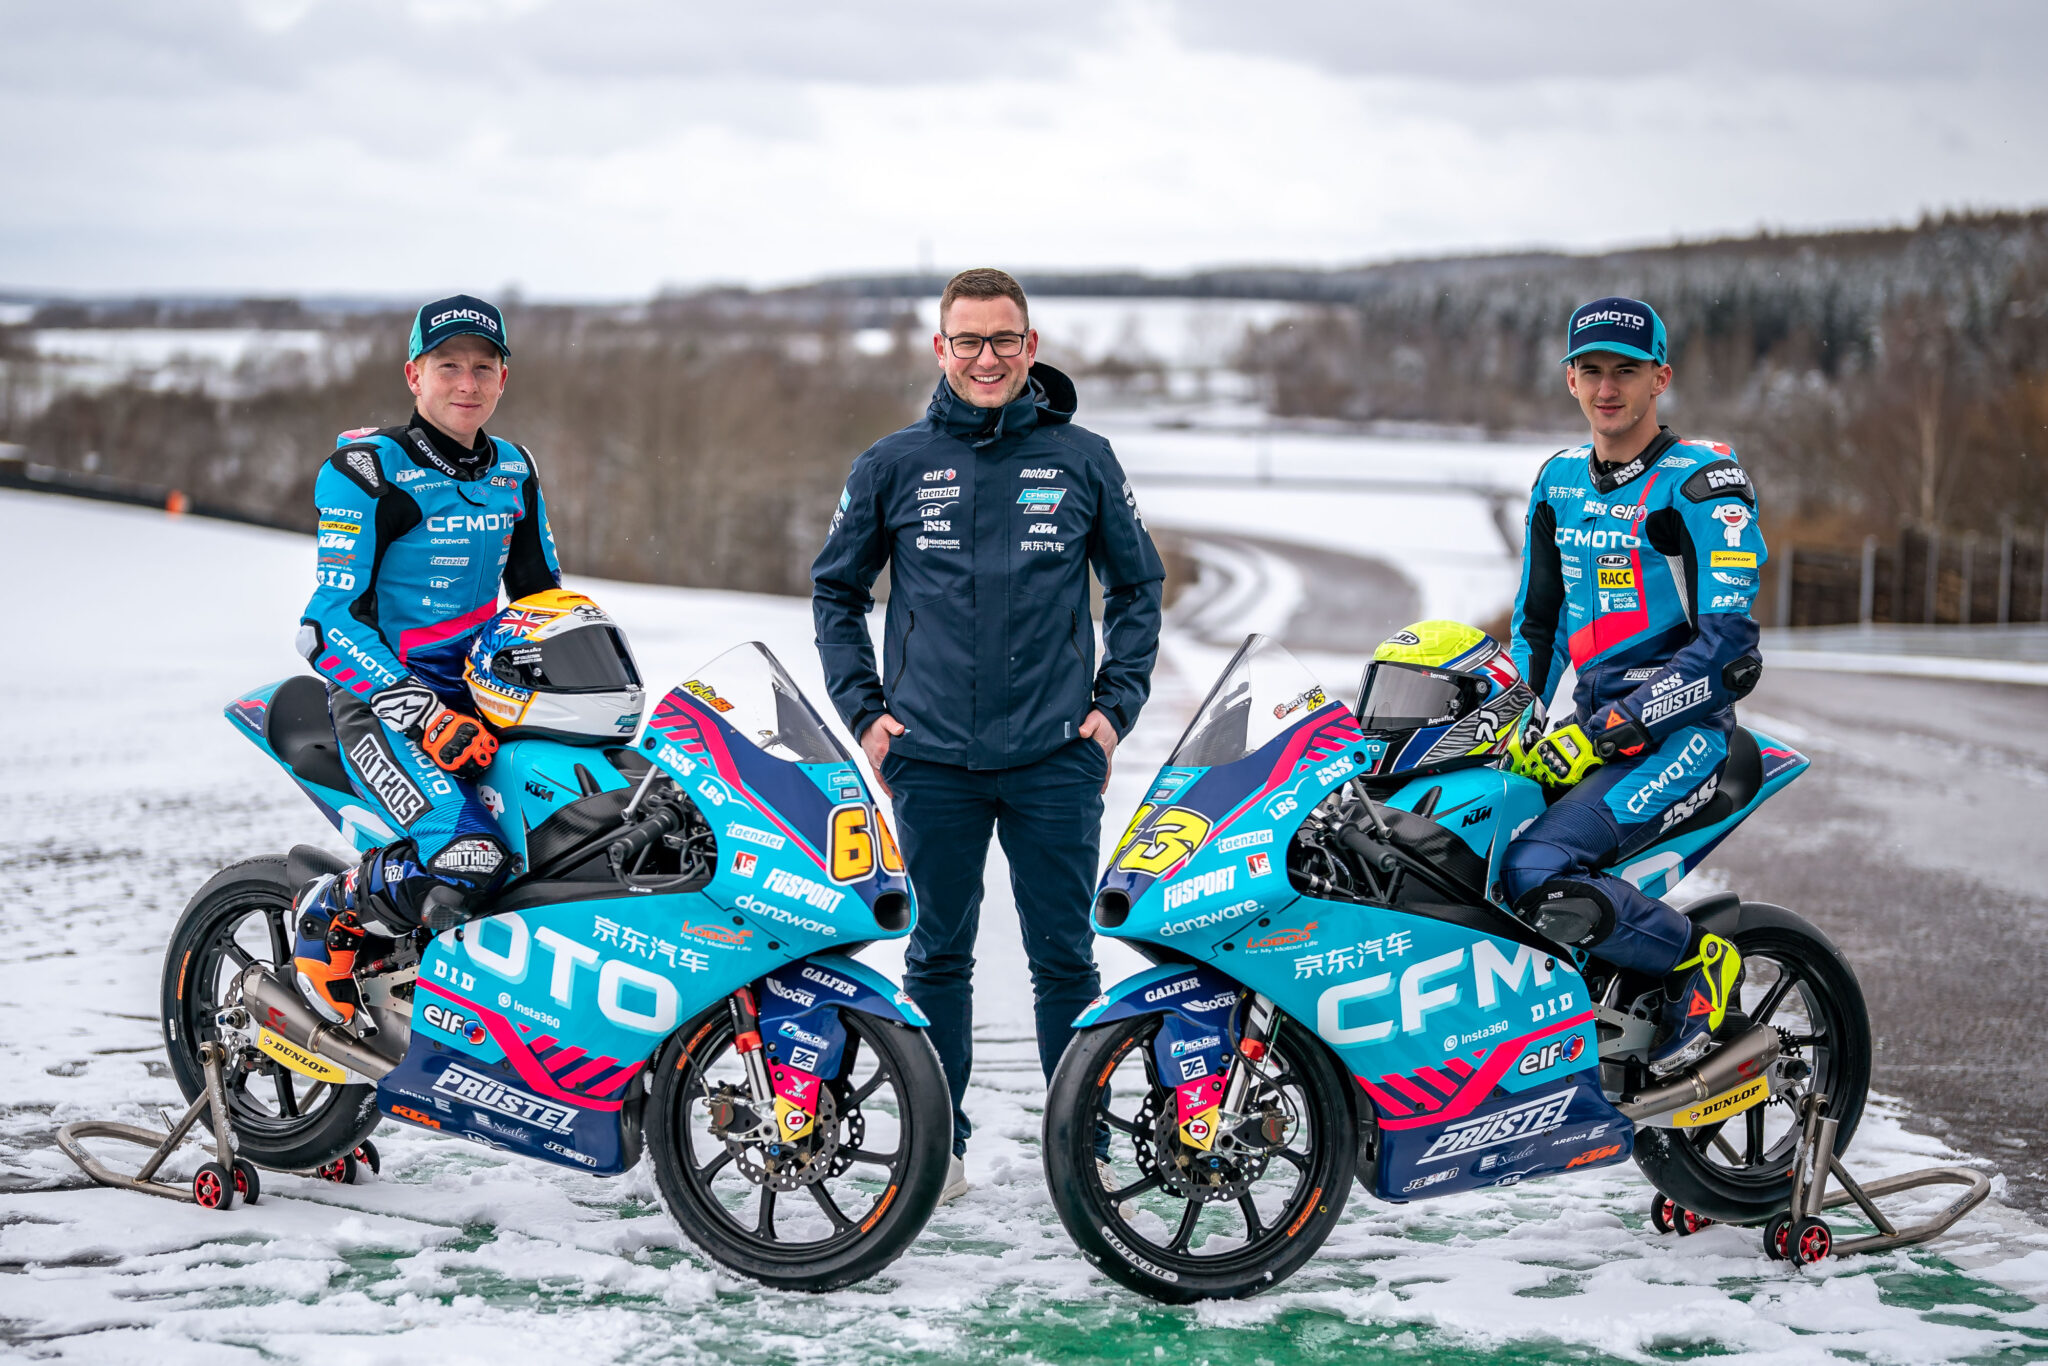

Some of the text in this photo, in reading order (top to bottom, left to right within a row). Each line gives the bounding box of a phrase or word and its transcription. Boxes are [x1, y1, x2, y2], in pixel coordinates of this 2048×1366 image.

[431, 309, 498, 330] CFMOTO
[1577, 311, 1645, 328] CFMOTO
[1616, 321, 1640, 331] RACING
[417, 440, 456, 476] CFMOTO
[396, 469, 426, 482] KTM
[490, 476, 507, 488] elf
[923, 470, 944, 481] elf
[915, 487, 958, 499] taenzler
[921, 508, 941, 517] LBS
[1610, 504, 1637, 520] elf
[1028, 523, 1058, 534] KTM
[1555, 528, 1642, 549] CFMOTO
[318, 533, 356, 551] KTM
[1020, 541, 1065, 552] 京东汽车
[1600, 557, 1625, 565] HJC
[430, 580, 449, 589] LBS
[1600, 572, 1631, 585] RACC
[328, 628, 397, 686] CFMOTO
[470, 670, 529, 703] Kabuto
[1624, 669, 1658, 679] PRÜST
[1307, 692, 1326, 711] 43
[1641, 676, 1713, 724] PRÜSTEL
[405, 739, 453, 795] MOTO
[1627, 733, 1707, 814] CFMOTO
[1688, 747, 1713, 776] RACING
[353, 741, 423, 823] MITHOS
[416, 771, 436, 799] RACING
[524, 780, 554, 802] KTM
[697, 779, 727, 806] LBS
[1268, 795, 1298, 821] LBS
[1461, 806, 1492, 828] KTM
[726, 821, 784, 849] taenzler
[1215, 830, 1272, 852] taenzler
[446, 851, 496, 867] MITHOS
[735, 894, 838, 938] danzware.
[1160, 900, 1265, 937] danzware.
[593, 915, 709, 973] 京东汽车
[1294, 930, 1413, 980] 京东汽车
[801, 967, 858, 998] GALFER
[1144, 977, 1201, 1003] GALFER
[778, 986, 815, 1008] SOCKE
[423, 1005, 463, 1033] elf
[514, 998, 561, 1030] Insta360
[1461, 1020, 1509, 1046] Insta360
[274, 1041, 330, 1075] DUNLOP
[1519, 1042, 1562, 1076] elf
[399, 1088, 432, 1104] ARENA
[435, 1068, 579, 1134] PRÜSTEL
[1703, 1085, 1761, 1117] DUNLOP
[391, 1104, 441, 1130] KTM
[1424, 1086, 1579, 1157] PRÜSTEL
[1552, 1133, 1587, 1147] ARENA
[1565, 1143, 1622, 1169] KTM
[1104, 1231, 1168, 1278] DUNLOP
